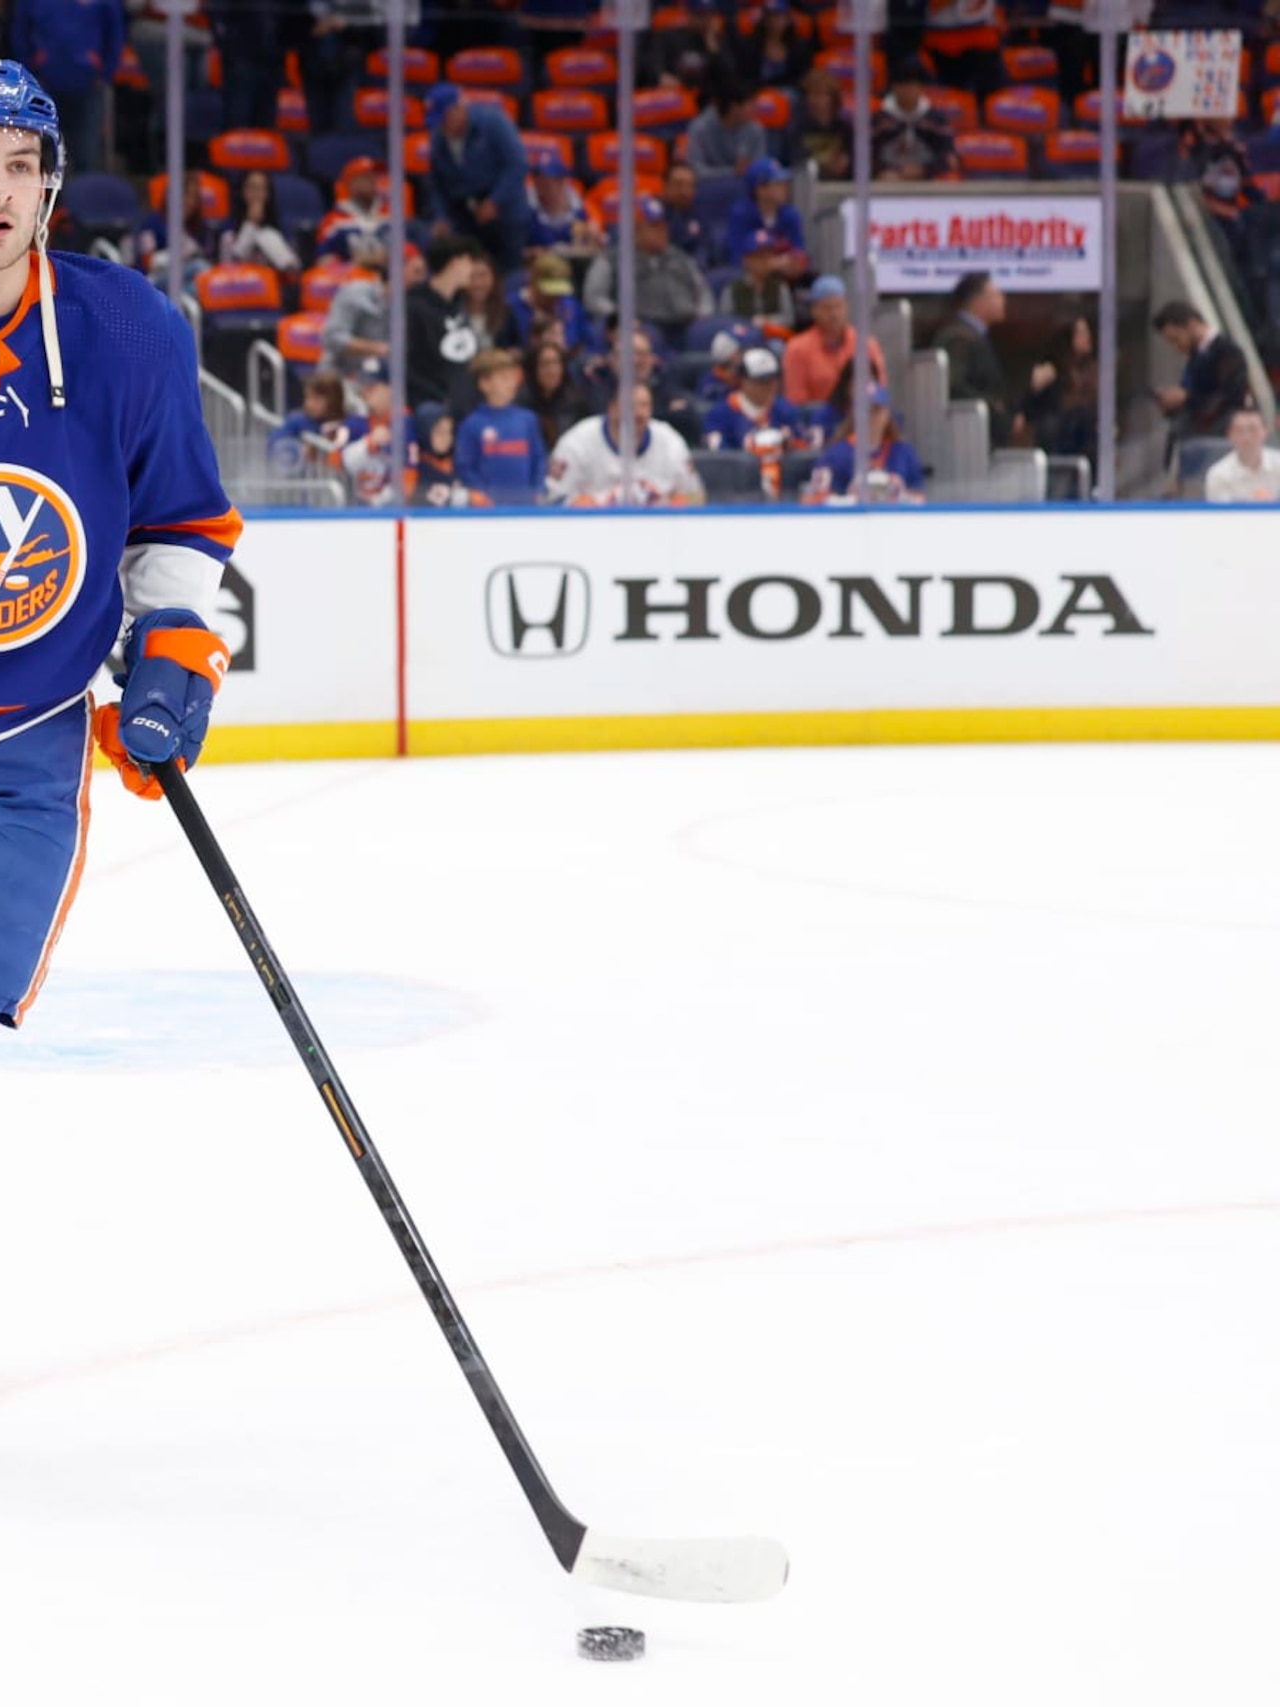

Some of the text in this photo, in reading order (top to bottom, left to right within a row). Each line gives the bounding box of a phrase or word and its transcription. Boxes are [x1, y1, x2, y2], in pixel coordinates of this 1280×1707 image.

[949, 213, 1086, 248] Authority
[614, 573, 1155, 641] HONDA
[132, 716, 170, 738] CCM
